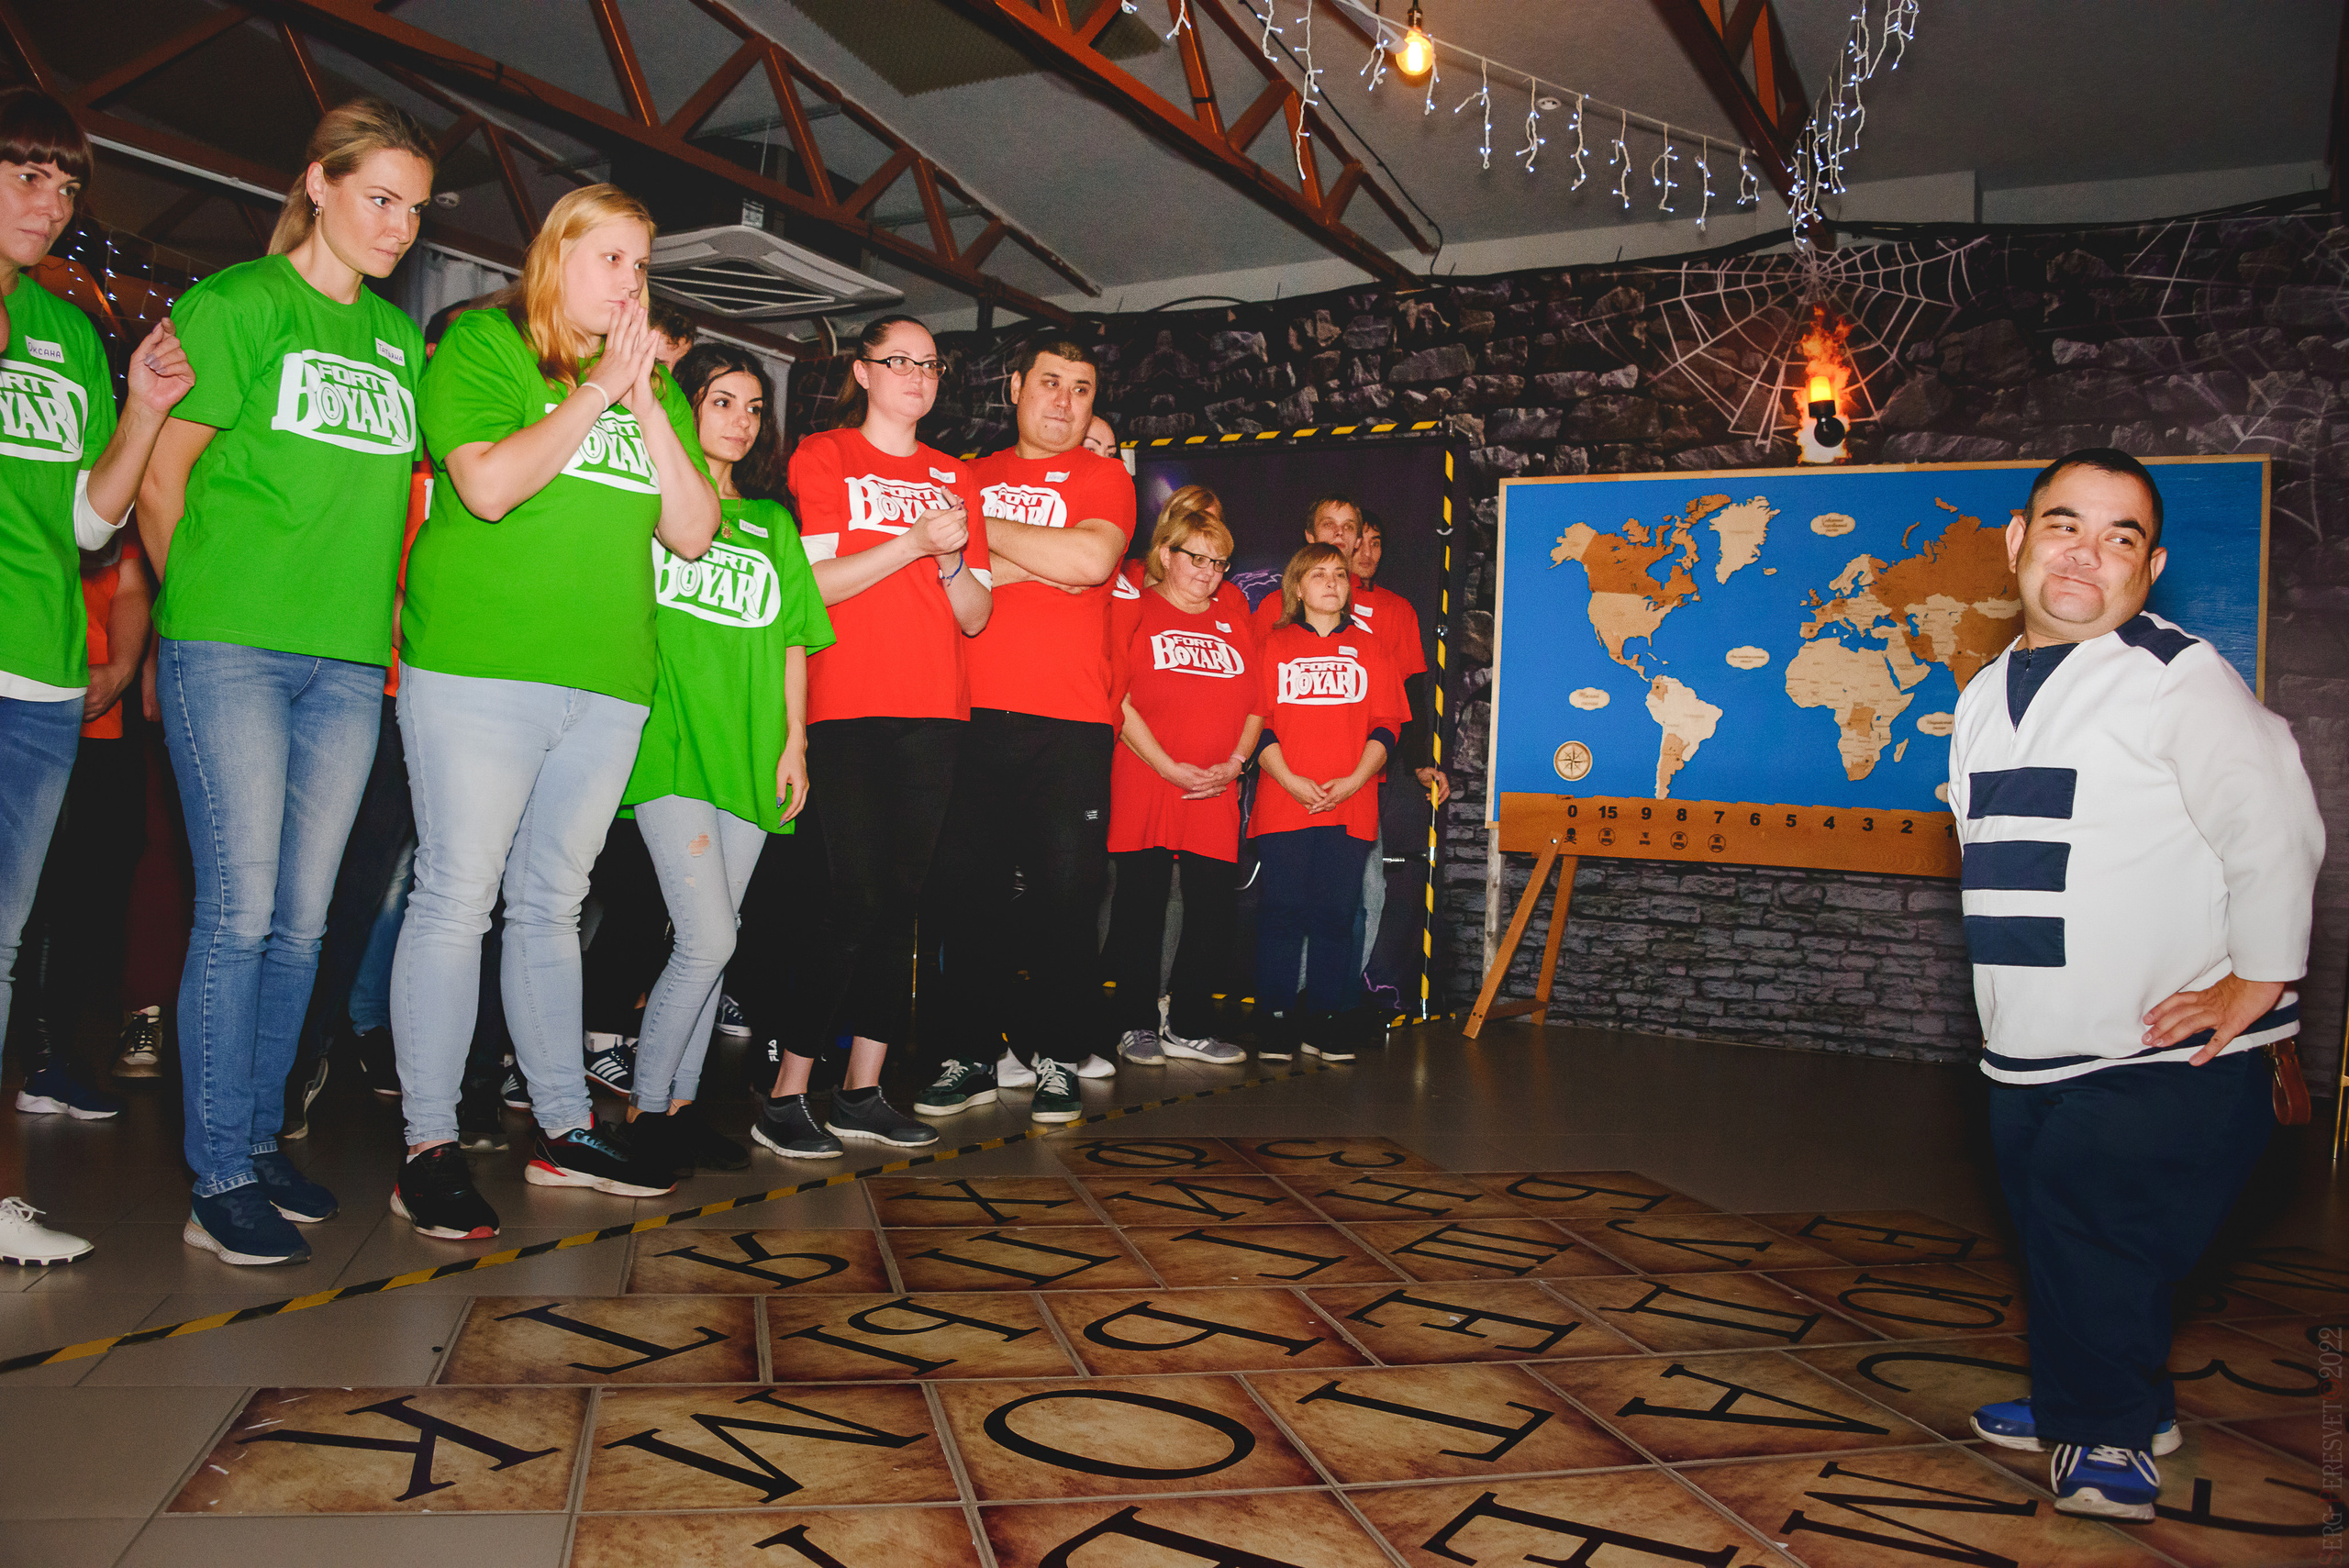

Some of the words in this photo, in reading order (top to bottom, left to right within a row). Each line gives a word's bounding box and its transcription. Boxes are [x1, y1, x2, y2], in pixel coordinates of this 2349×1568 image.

[271, 351, 417, 449] BOYARD
[317, 361, 380, 392] FORT
[877, 483, 934, 500] FORT
[651, 536, 782, 626] BOYARD
[1150, 633, 1245, 675] BOYARD
[1172, 635, 1214, 649] FORT
[1299, 662, 1345, 673] FORT
[1276, 662, 1368, 705] BOYARD
[1567, 805, 1577, 817] 0
[1598, 806, 1618, 819] 15
[1642, 806, 1652, 820] 9
[1676, 807, 1687, 821] 8
[1714, 811, 1725, 824] 7
[1750, 813, 1761, 826] 6
[1786, 814, 1797, 828] 5
[1823, 816, 1835, 829] 4
[1862, 817, 1874, 831] 3
[1900, 819, 1913, 834] 2
[1944, 824, 1954, 838] 1
[1073, 1140, 1222, 1171] Ф
[886, 1178, 1076, 1225] Х
[1103, 1176, 1289, 1222] И
[1315, 1175, 1485, 1218] Н
[1505, 1174, 1674, 1213] Б
[652, 1231, 850, 1290] Я
[906, 1229, 1122, 1286] П
[1168, 1229, 1350, 1281] Г
[1389, 1223, 1576, 1277] Ш
[1606, 1218, 1774, 1268] У
[1796, 1215, 1982, 1262] Е
[1344, 1288, 1583, 1355] Е
[1597, 1279, 1823, 1344] Д
[1837, 1273, 2014, 1329] Ю
[493, 1302, 732, 1375] Т
[1295, 1379, 1556, 1462] Т
[1614, 1362, 1891, 1436] А
[234, 1394, 562, 1502] К
[602, 1387, 929, 1504] М
[983, 1388, 1257, 1481] О
[1778, 1461, 2039, 1568] М
